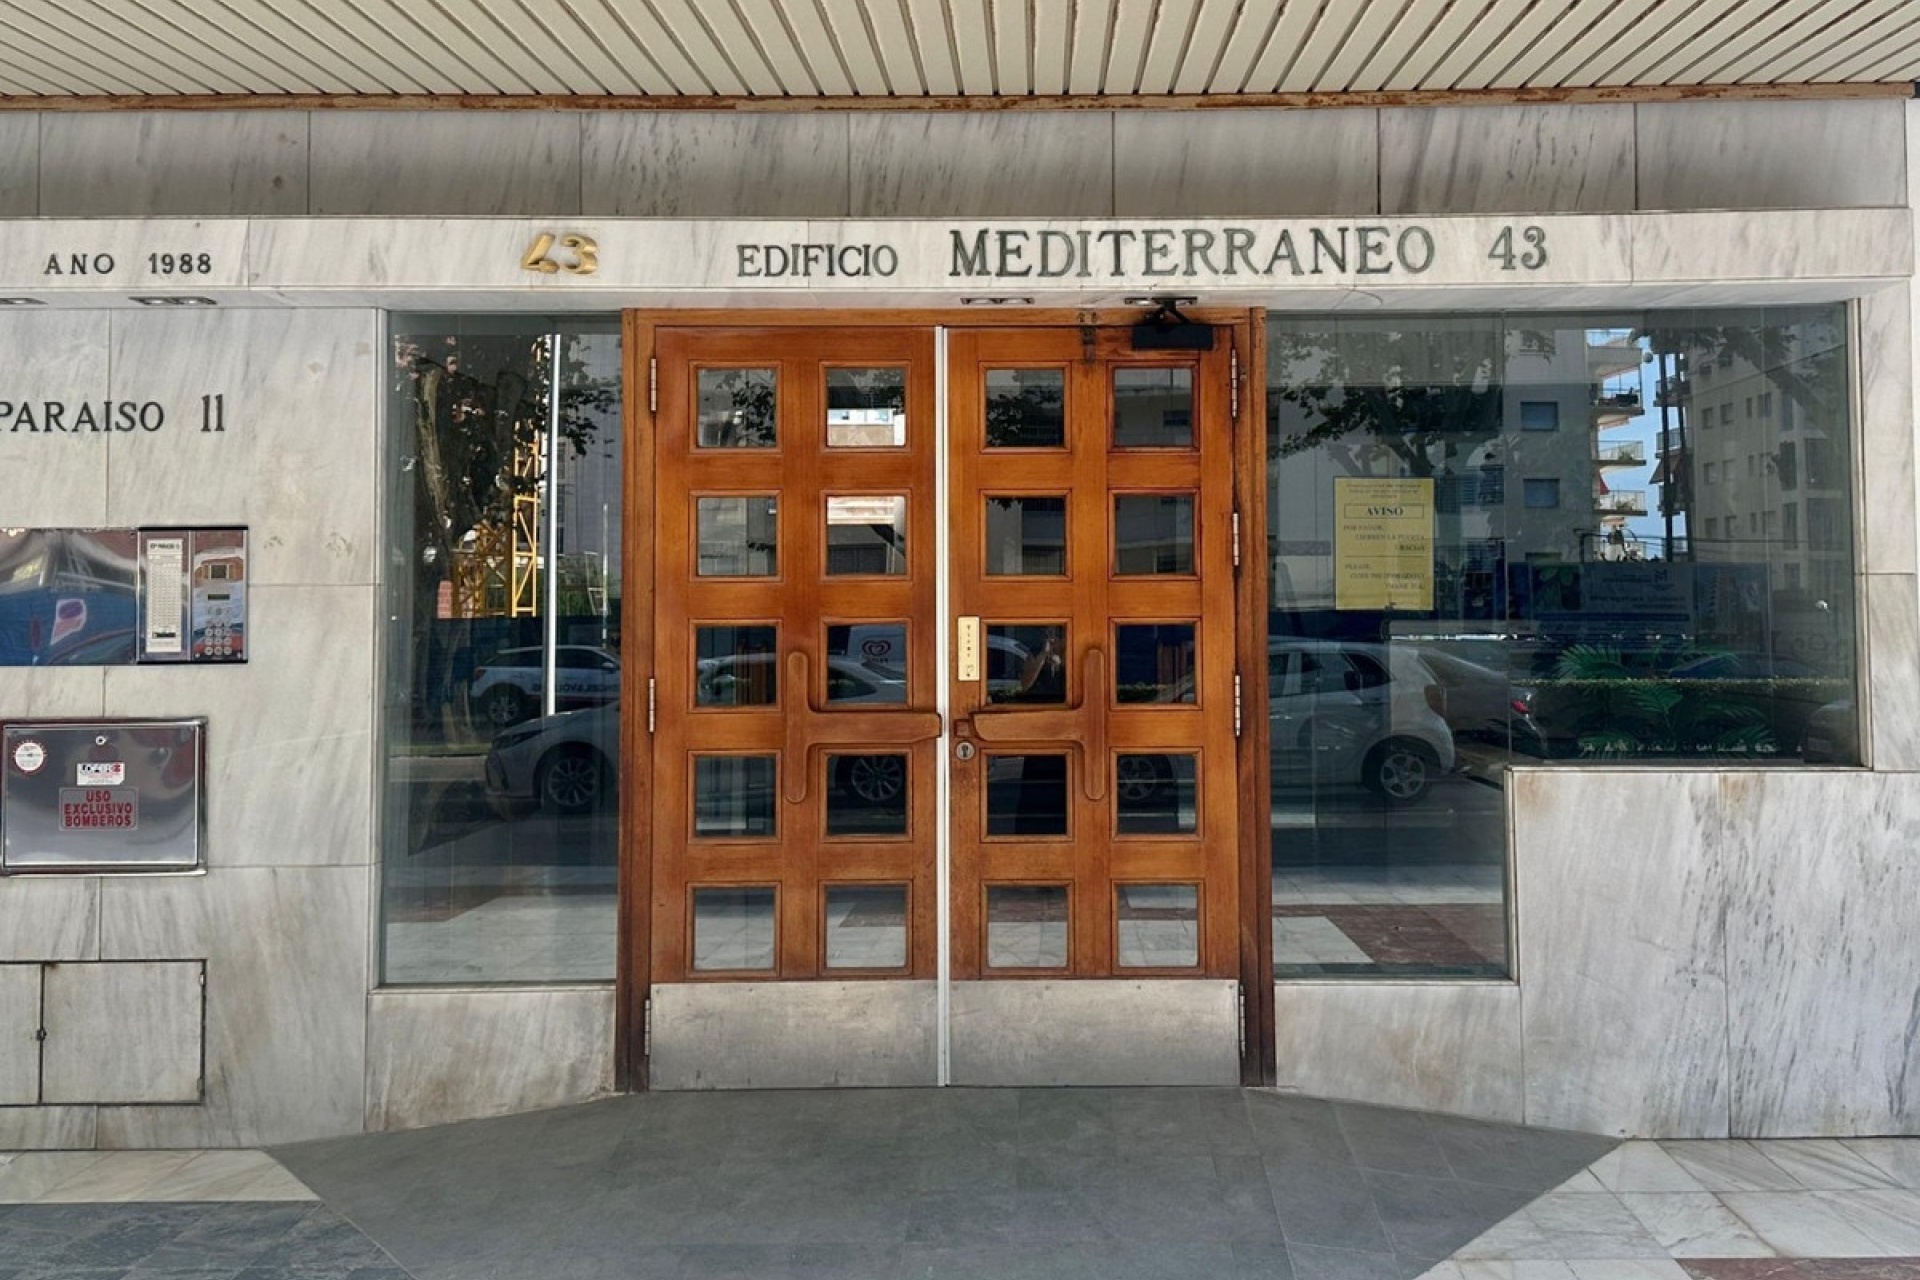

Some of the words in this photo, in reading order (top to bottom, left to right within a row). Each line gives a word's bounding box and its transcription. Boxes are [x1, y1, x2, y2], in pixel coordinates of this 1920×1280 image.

[737, 243, 898, 277] EDIFICIO
[948, 225, 1435, 278] MEDITERRANEO
[1487, 225, 1548, 270] 43
[44, 252, 115, 275] ANO
[148, 252, 212, 275] 1988
[0, 400, 165, 433] PARAISO
[201, 393, 225, 433] 11
[1366, 505, 1404, 517] AVISO
[86, 790, 112, 802] USO
[64, 802, 133, 815] EXCLUSIVO
[65, 814, 132, 827] BOMBEROS
